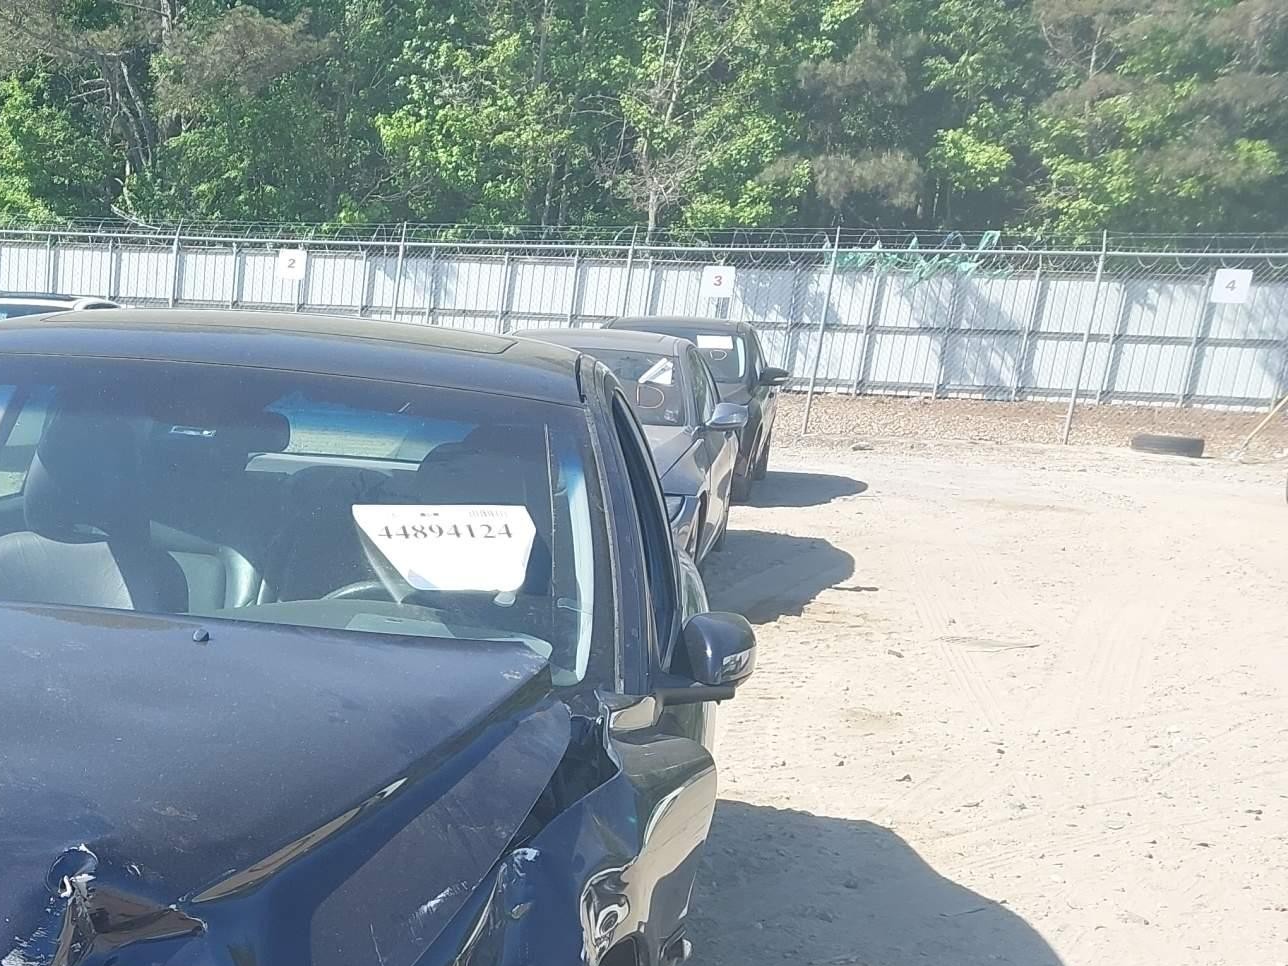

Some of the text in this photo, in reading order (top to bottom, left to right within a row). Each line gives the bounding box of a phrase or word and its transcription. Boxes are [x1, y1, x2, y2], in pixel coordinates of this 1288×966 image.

[287, 258, 296, 269] 2
[713, 275, 723, 287] 3
[1224, 279, 1237, 291] 4
[378, 523, 513, 540] 44894124
